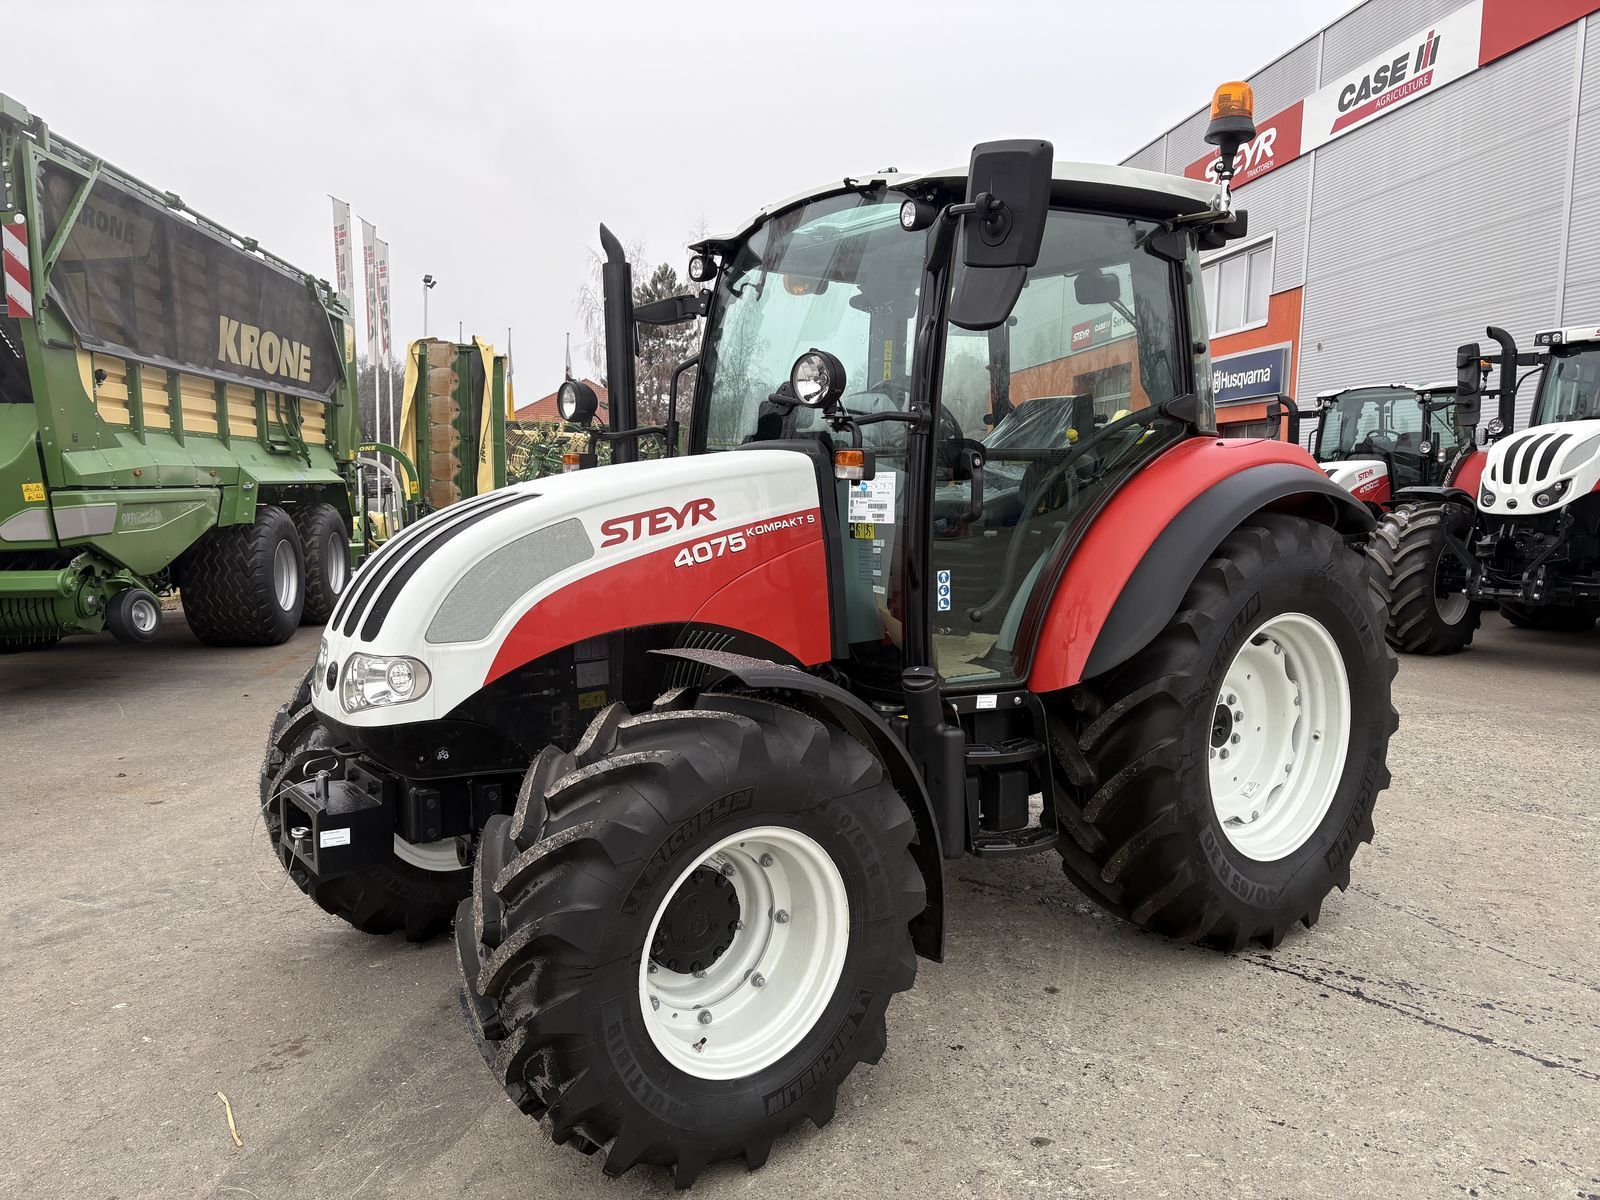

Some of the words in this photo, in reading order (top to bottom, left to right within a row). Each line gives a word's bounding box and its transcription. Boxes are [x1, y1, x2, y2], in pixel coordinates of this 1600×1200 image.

[1338, 52, 1410, 113] CASE
[1376, 75, 1429, 109] AGRICULTURE
[1205, 127, 1277, 185] SEYR
[1247, 160, 1274, 178] TRAKTOREN
[81, 206, 136, 243] RONE
[218, 315, 311, 383] KRONE
[1073, 328, 1090, 342] STEYR
[1221, 367, 1271, 389] Husqvarna
[1358, 469, 1374, 481] STEYR
[1360, 482, 1374, 493] 4100
[601, 498, 717, 548] STEYR
[674, 532, 747, 568] 4075
[746, 516, 804, 538] KOMPAKT
[807, 514, 815, 524] S
[644, 788, 753, 888] MICHELIN
[1204, 832, 1221, 867] 30
[1219, 859, 1231, 882] R
[766, 1016, 858, 1118] MICHELIN
